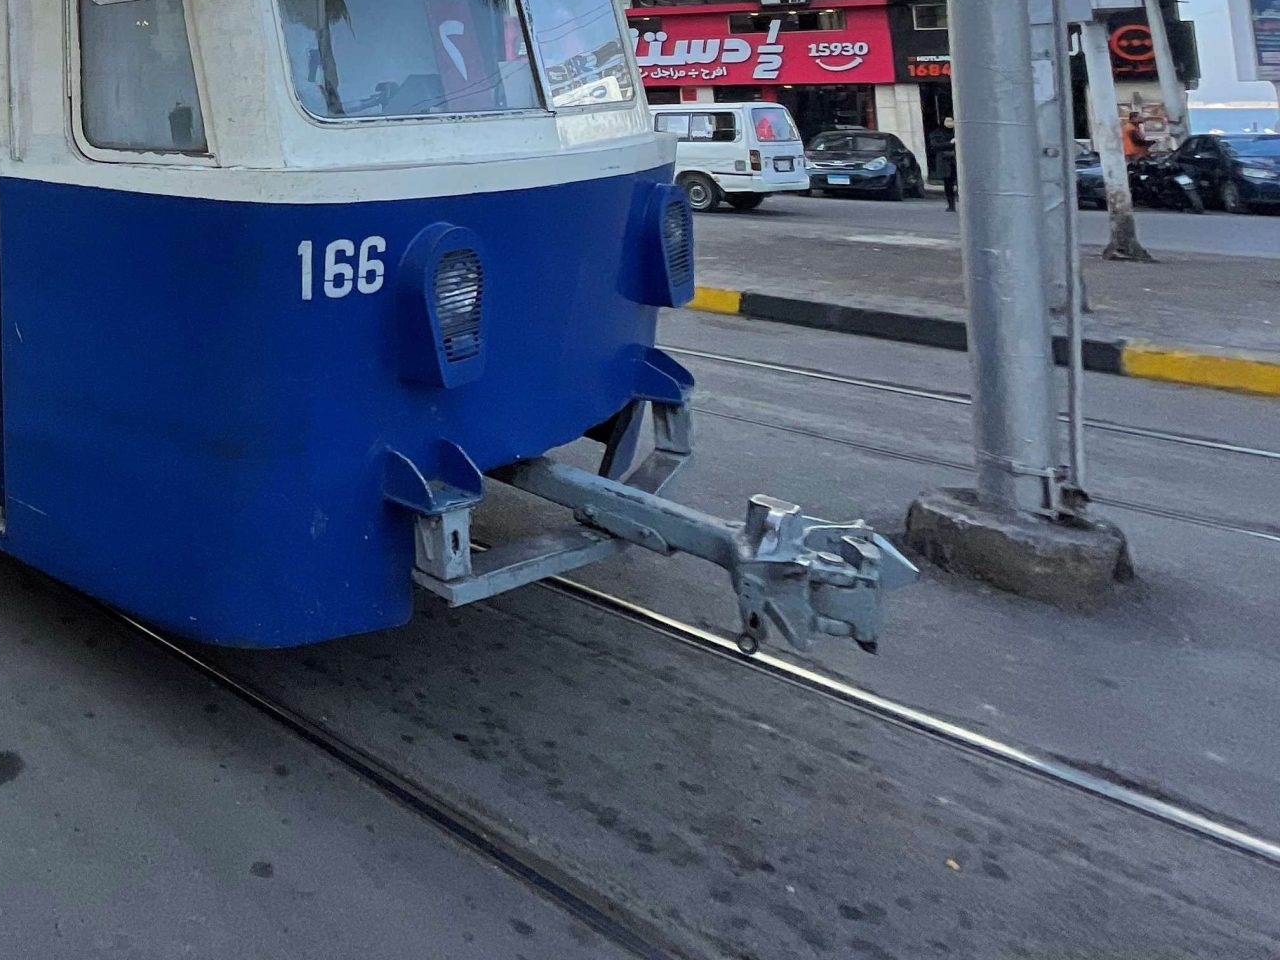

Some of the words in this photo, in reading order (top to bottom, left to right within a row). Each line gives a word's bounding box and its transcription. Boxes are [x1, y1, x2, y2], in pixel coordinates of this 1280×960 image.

[808, 42, 869, 57] 15930
[701, 66, 727, 80] افرح
[297, 235, 387, 301] 166
